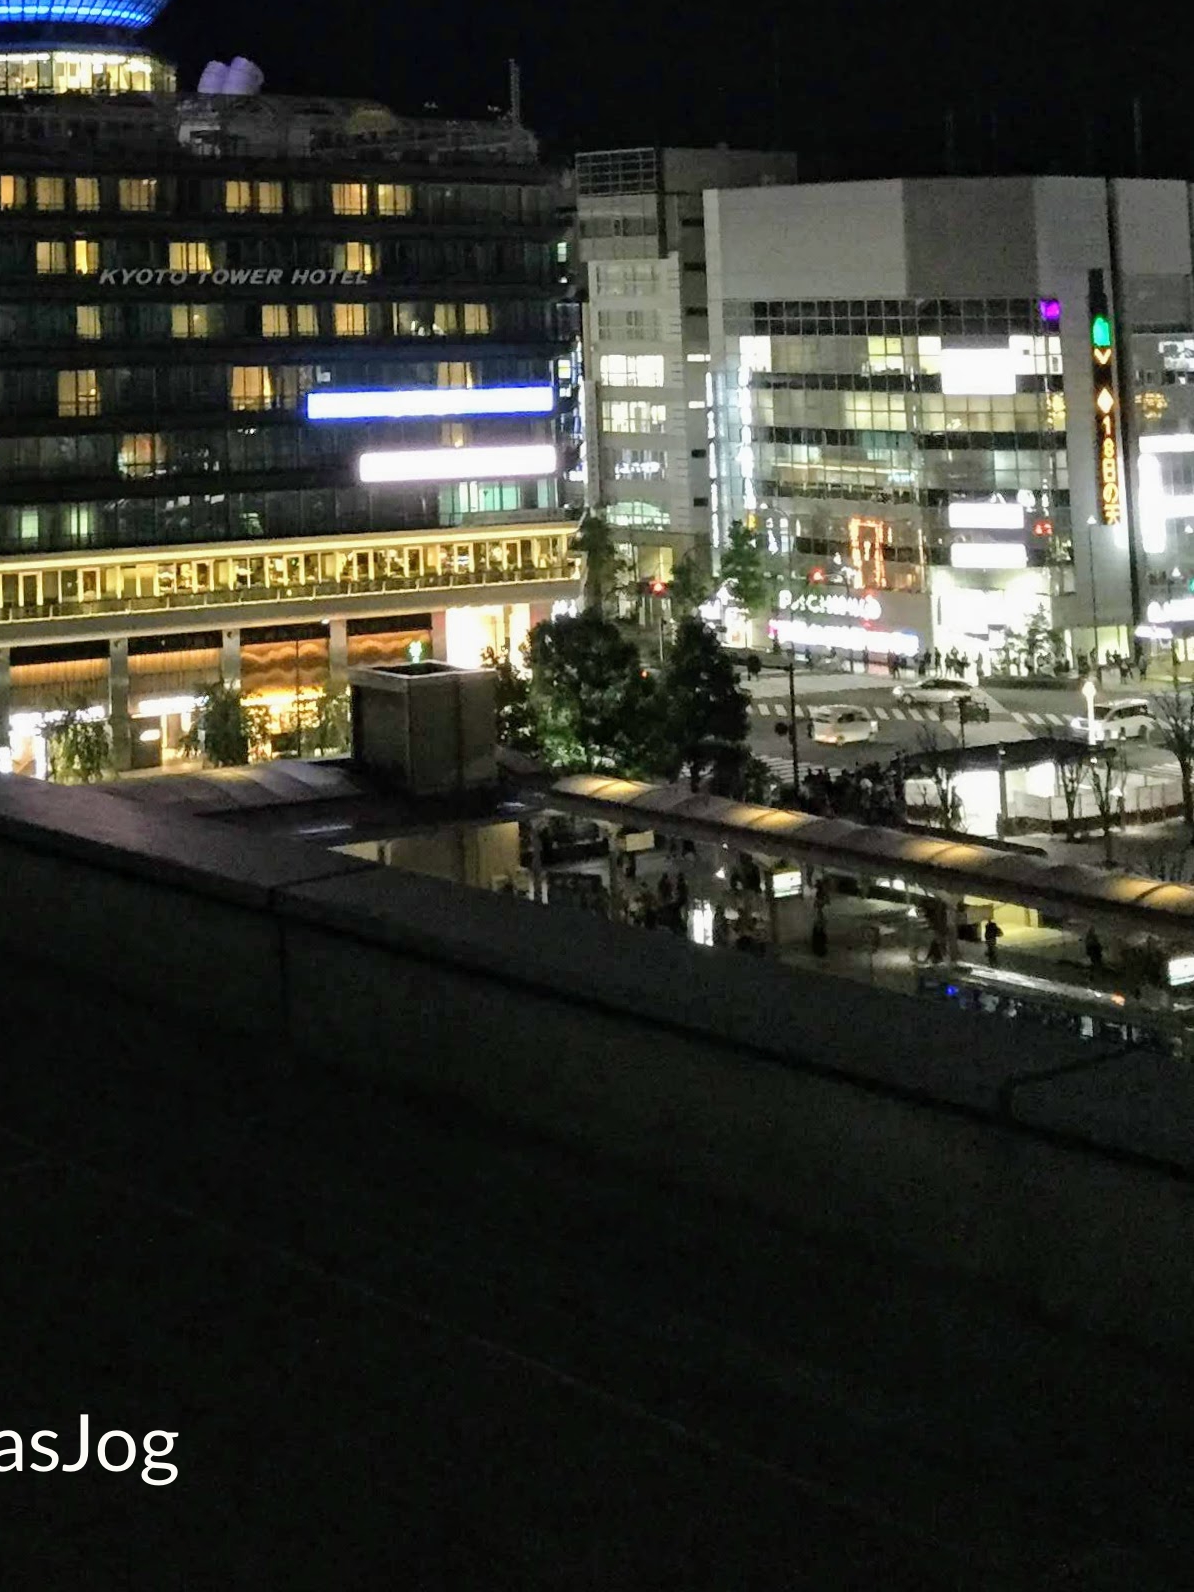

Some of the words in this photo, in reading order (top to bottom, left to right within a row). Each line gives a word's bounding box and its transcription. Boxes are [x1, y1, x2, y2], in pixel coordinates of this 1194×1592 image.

[99, 268, 187, 285] KYOTO
[198, 269, 283, 285] TOWER
[290, 270, 369, 285] HOTEL
